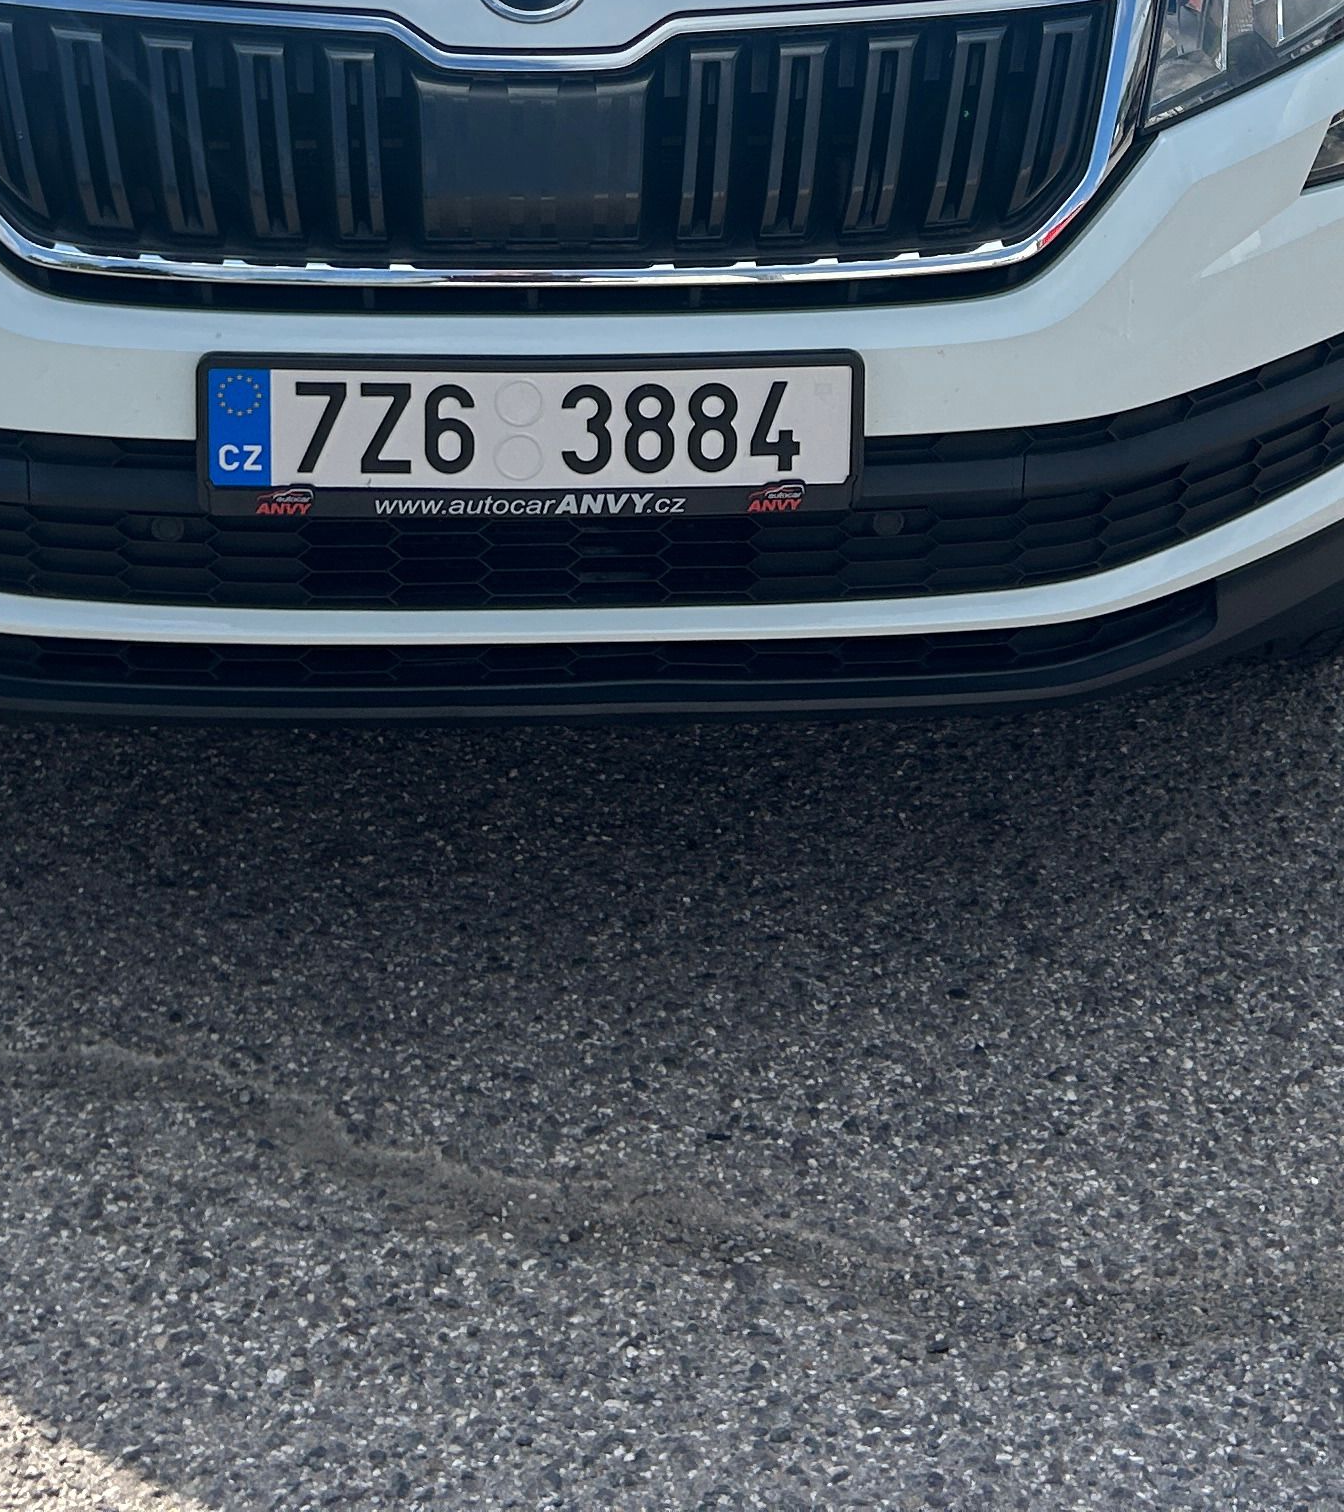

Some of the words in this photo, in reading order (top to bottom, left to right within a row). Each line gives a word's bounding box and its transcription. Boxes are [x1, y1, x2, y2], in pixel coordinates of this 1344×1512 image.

[294, 381, 476, 474] 7Z6
[561, 381, 801, 474] 3884
[218, 444, 263, 471] CZ
[256, 502, 312, 515] ANVY
[374, 492, 686, 515] www.autocarANVY.cz
[747, 498, 802, 512] ANVY
